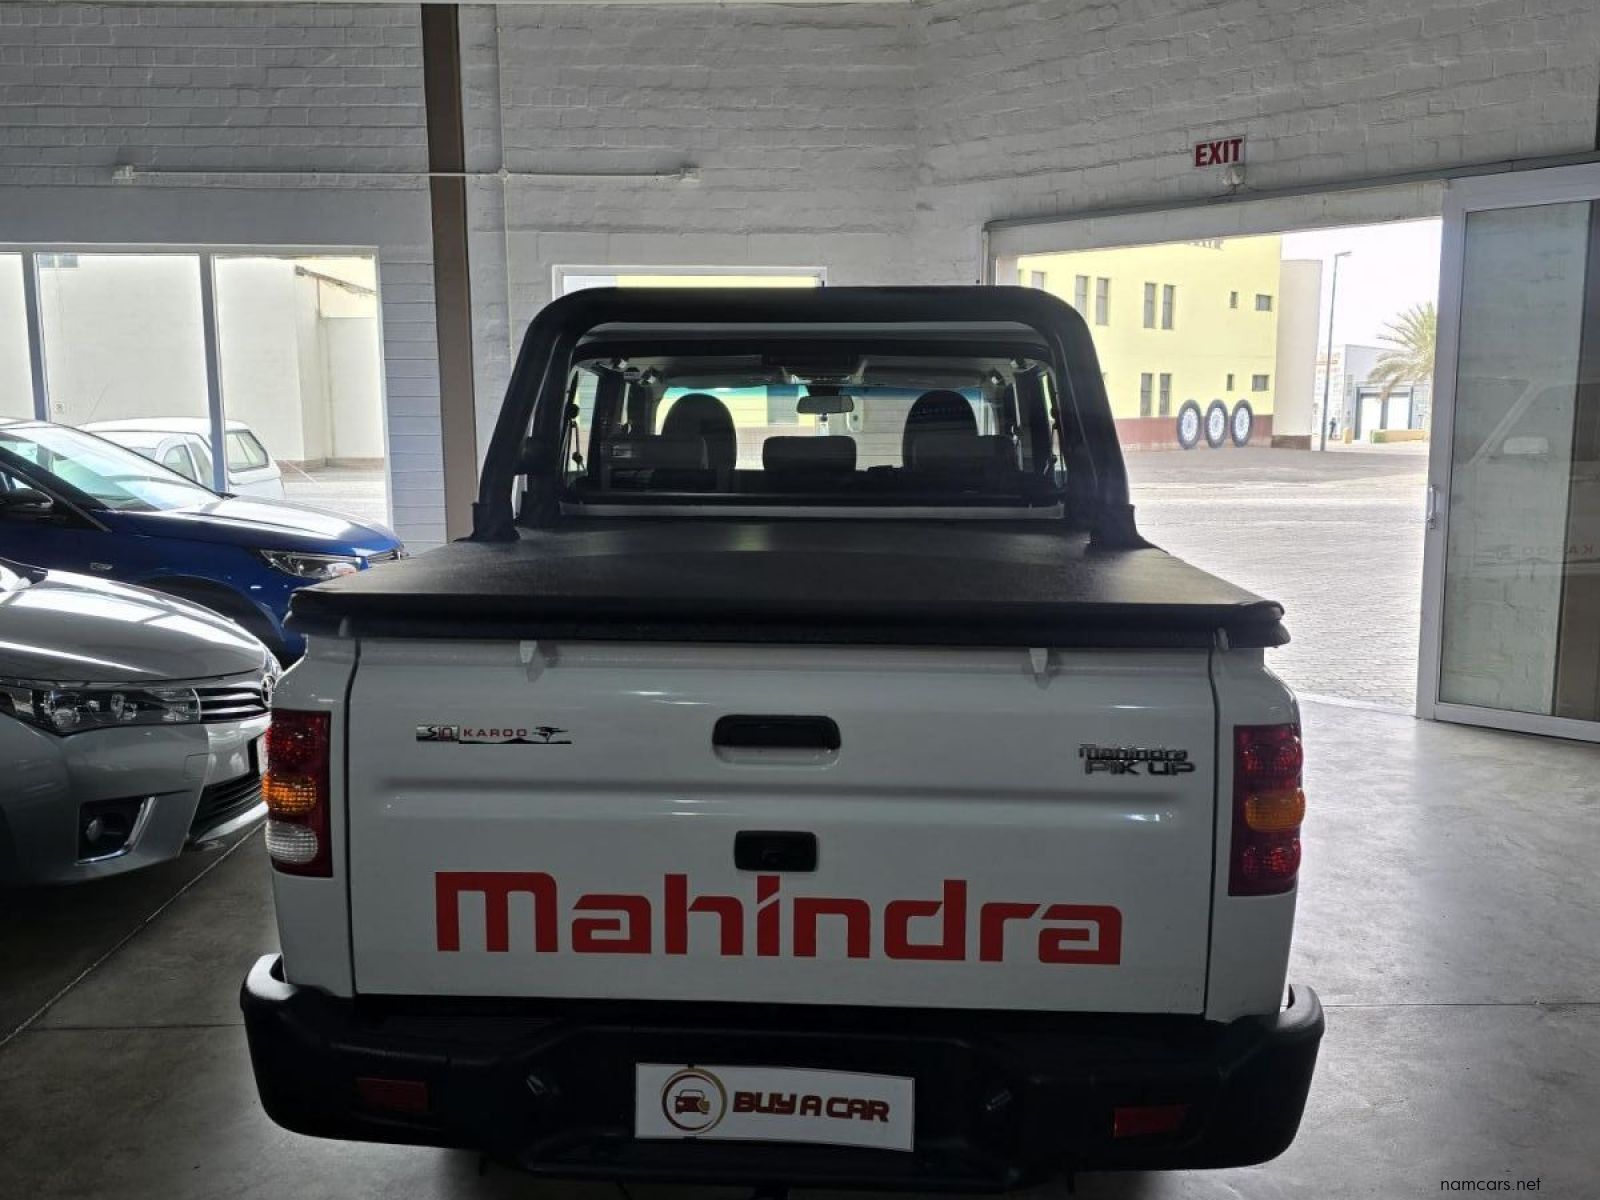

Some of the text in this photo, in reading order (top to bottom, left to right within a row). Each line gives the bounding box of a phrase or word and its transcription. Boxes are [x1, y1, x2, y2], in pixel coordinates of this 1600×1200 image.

[1195, 138, 1243, 167] EXIT
[463, 728, 528, 738] KAROO
[1085, 760, 1196, 776] PIK UP
[732, 1091, 890, 1123] BUY A CAR
